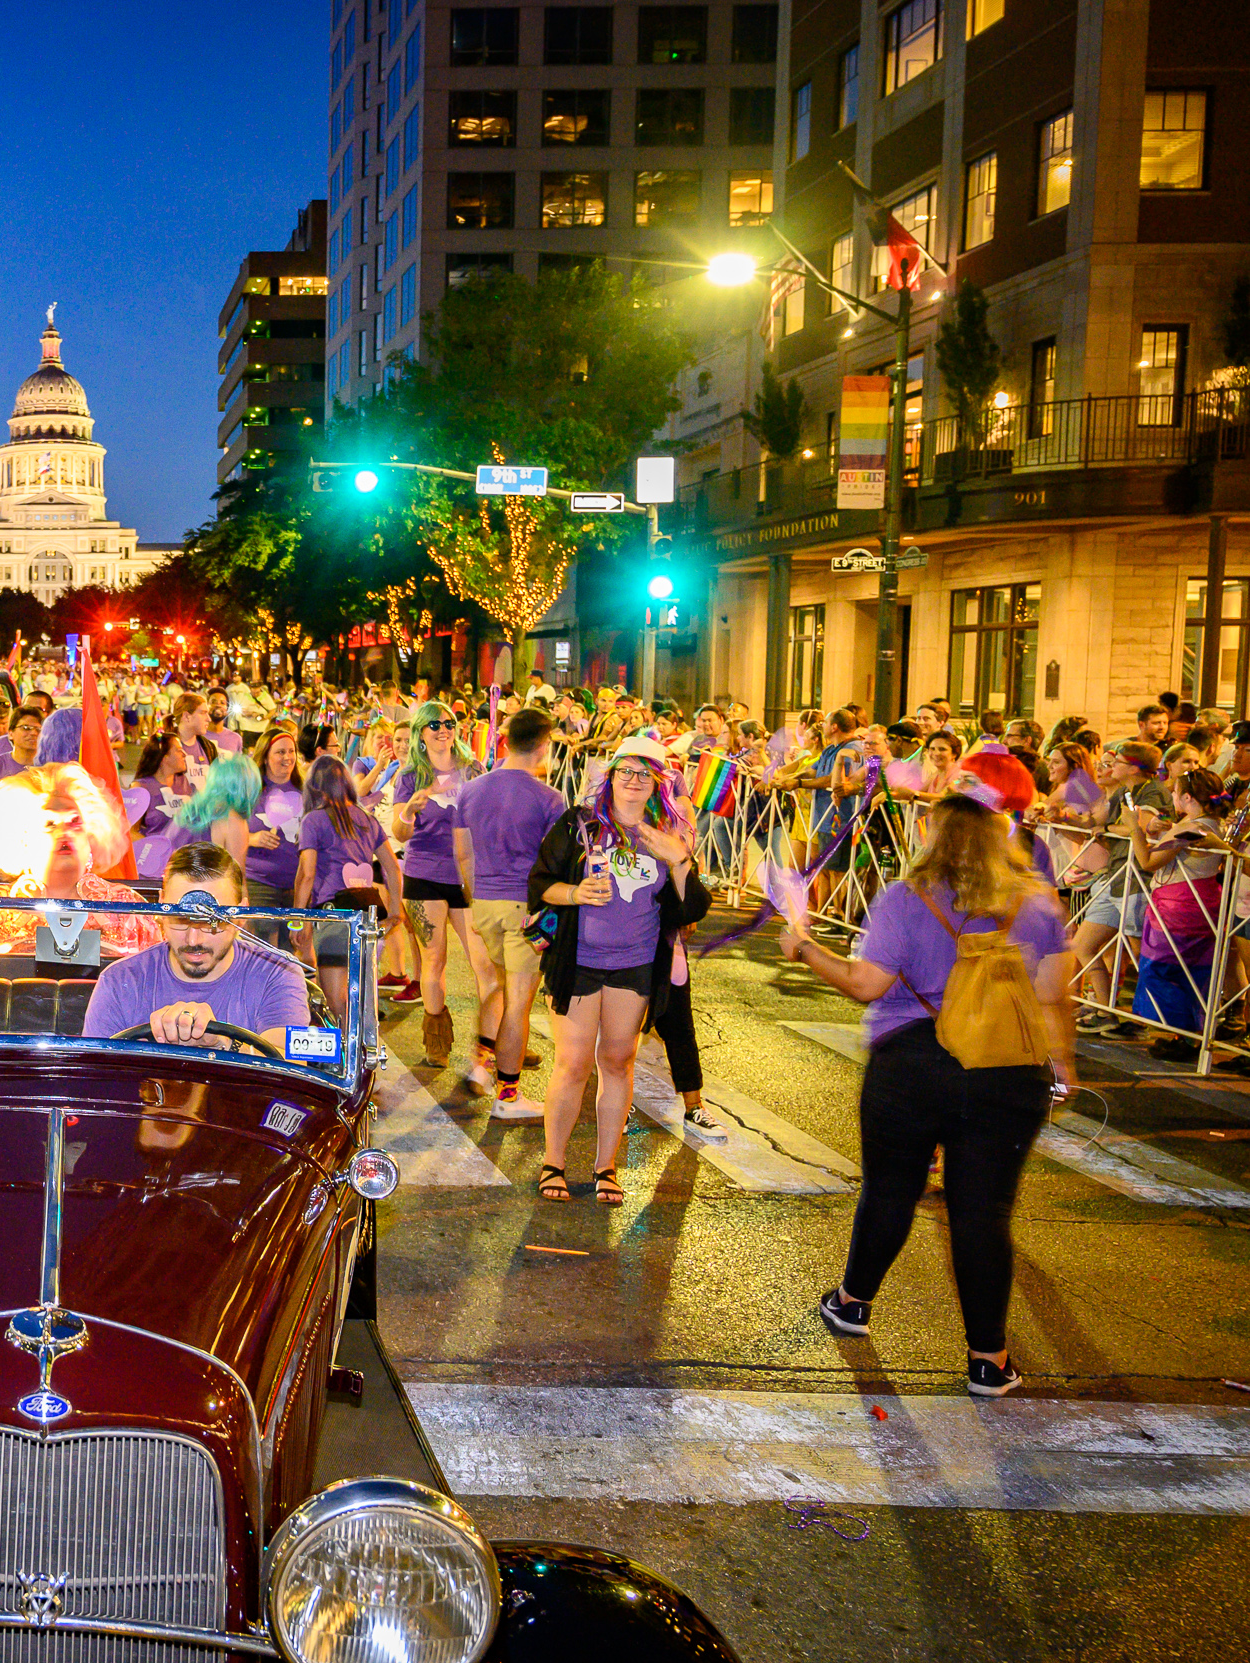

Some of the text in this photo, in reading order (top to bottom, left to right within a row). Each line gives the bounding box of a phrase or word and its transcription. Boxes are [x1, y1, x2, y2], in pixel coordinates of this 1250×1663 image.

[840, 471, 884, 482] AUSTIN
[1013, 490, 1046, 506] 901
[759, 513, 840, 543] FOUNDATION
[834, 559, 841, 567] E
[189, 767, 204, 777] LOVE
[610, 851, 641, 870] LOVE
[26, 1396, 63, 1413] Ford
